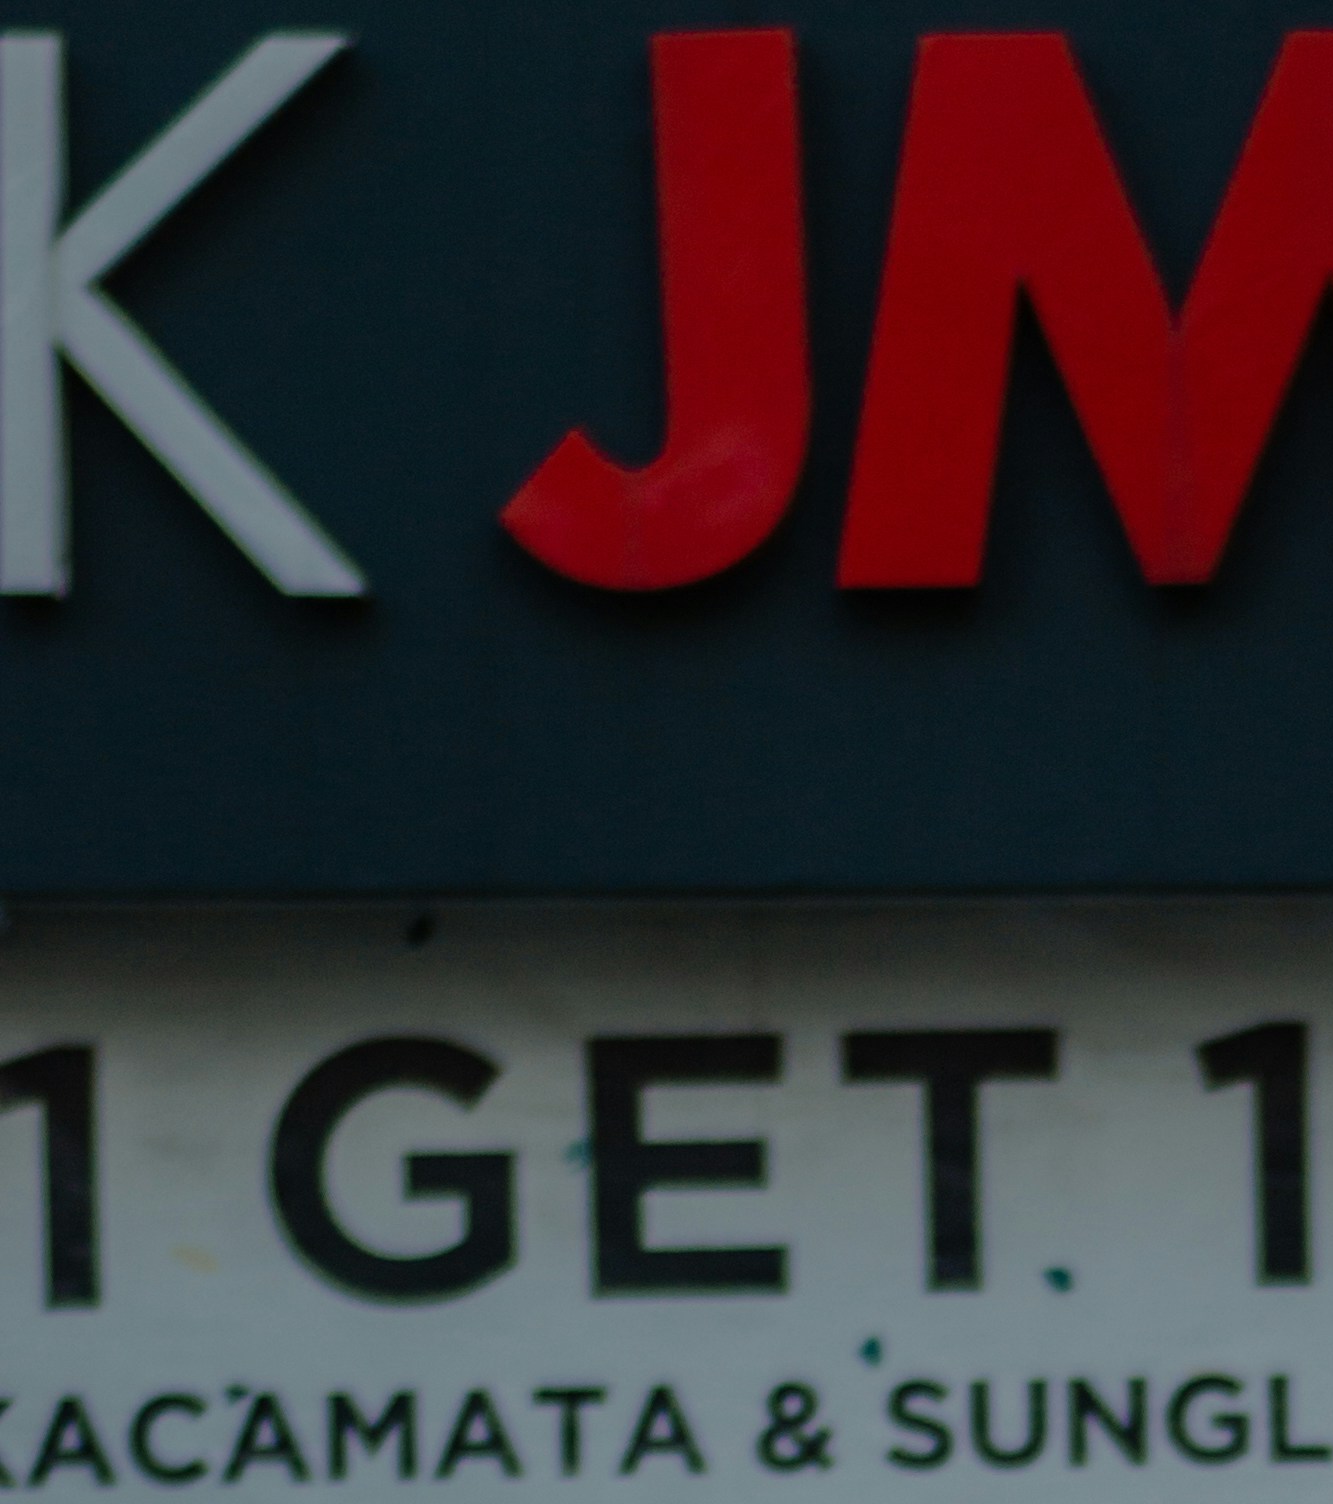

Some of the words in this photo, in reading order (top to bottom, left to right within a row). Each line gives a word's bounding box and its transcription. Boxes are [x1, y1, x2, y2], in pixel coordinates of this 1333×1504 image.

[272, 1027, 1058, 1306] GET
[1196, 1020, 1310, 1285] 1
[0, 1383, 704, 1487] ACAMATA
[760, 1383, 833, 1472] &
